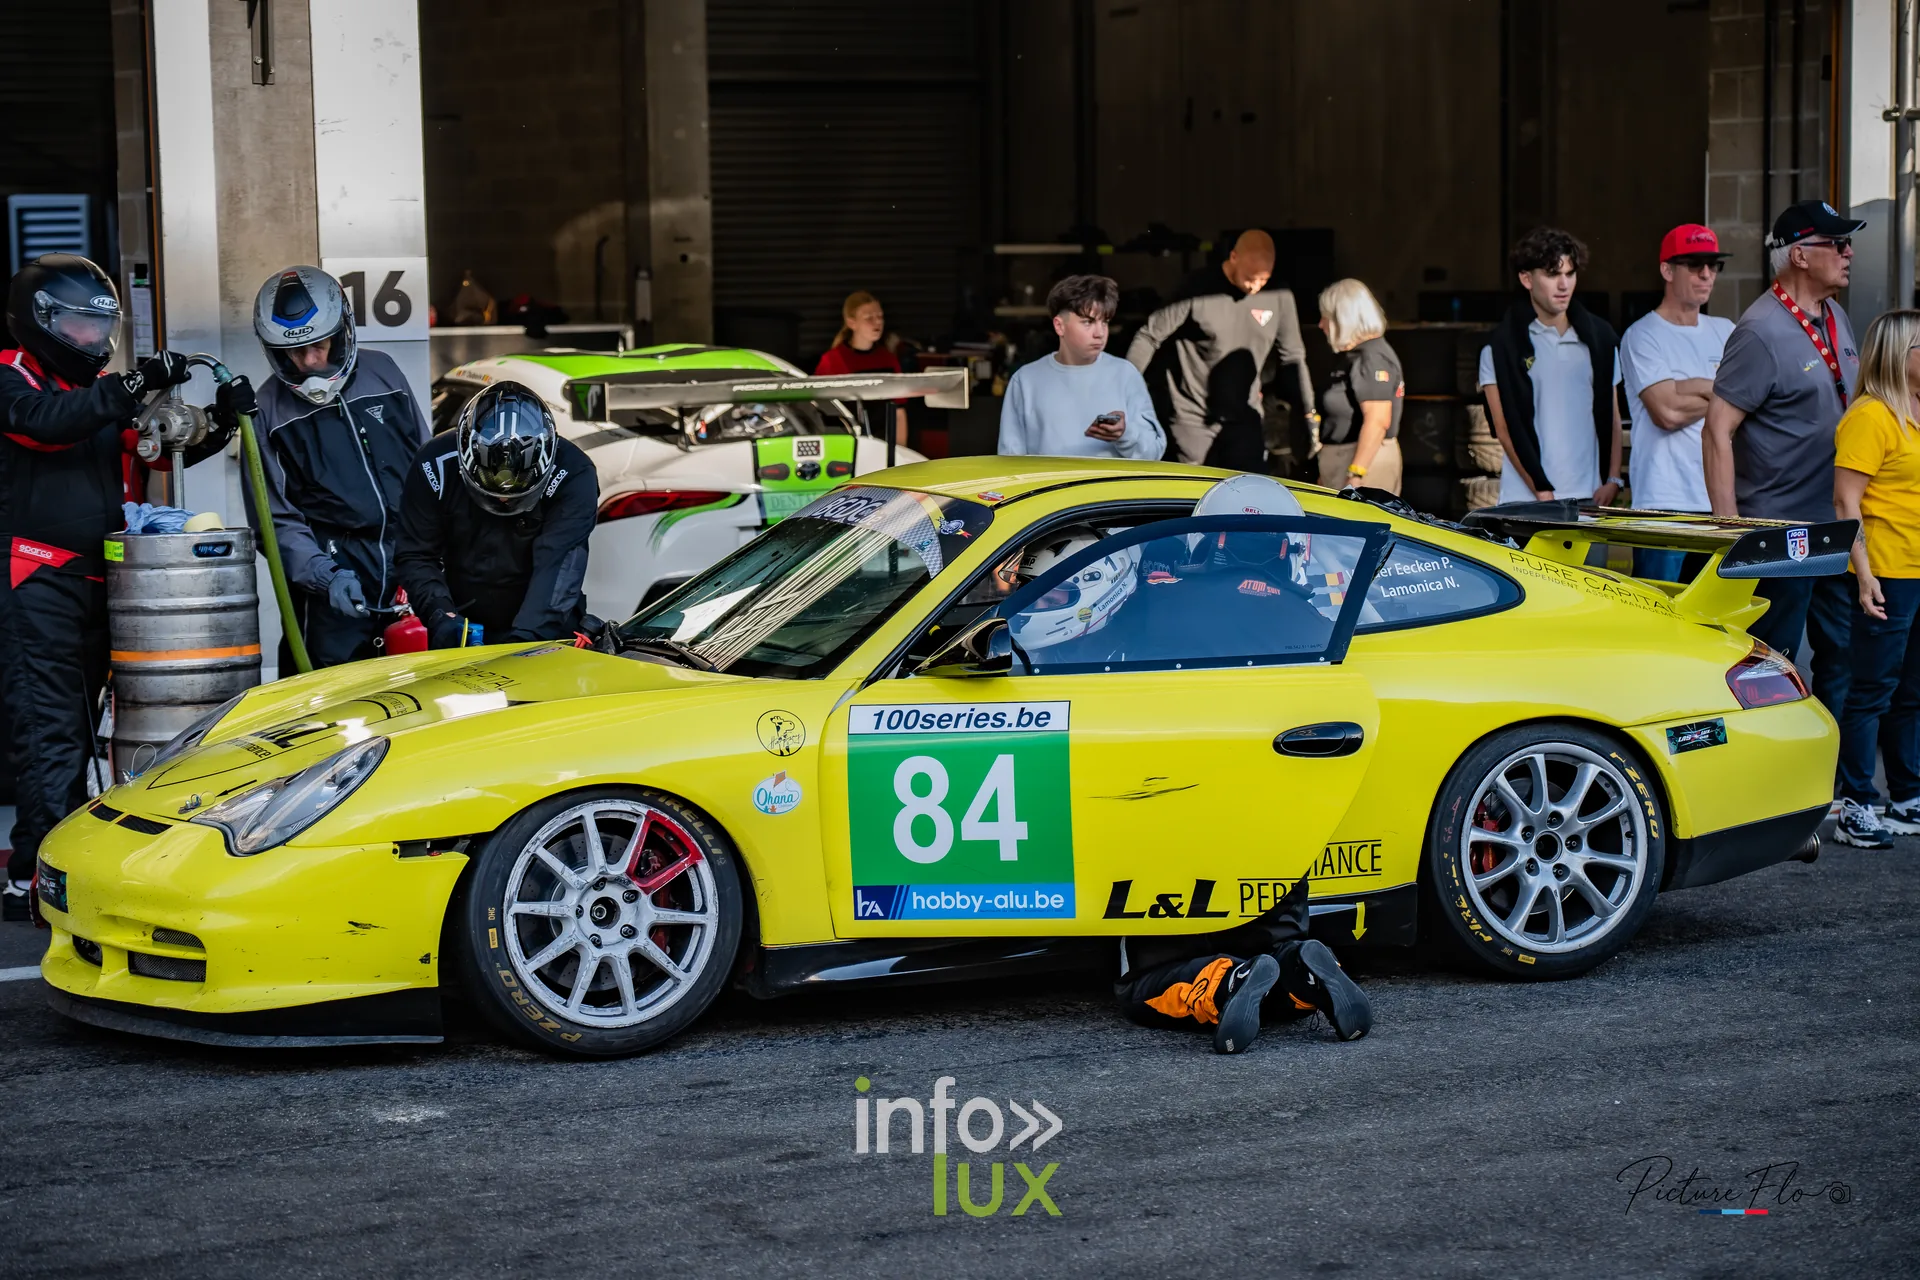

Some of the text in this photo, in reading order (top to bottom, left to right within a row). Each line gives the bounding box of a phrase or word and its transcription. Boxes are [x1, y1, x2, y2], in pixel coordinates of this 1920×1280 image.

[97, 298, 118, 308] HJC
[339, 270, 412, 328] 16
[287, 327, 310, 337] HJC
[422, 461, 441, 492] sparco
[546, 469, 568, 497] sparco
[18, 544, 53, 559] sparco
[1394, 560, 1440, 576] Eecken
[1441, 556, 1453, 569] P.
[1237, 579, 1267, 592] ATOM
[1381, 576, 1460, 598] Lamonica N.
[1509, 552, 1684, 616] PURE CAPITAL
[1513, 566, 1686, 621] INDEPENDENT ASSET MANAGEMENT
[1098, 587, 1124, 612] Lamonica
[872, 707, 1052, 731] 100series.be
[757, 788, 794, 806] Ohana
[893, 753, 1029, 864] 84
[912, 890, 1065, 913] hobby-alu.be
[1102, 878, 1298, 919] L&L PER
